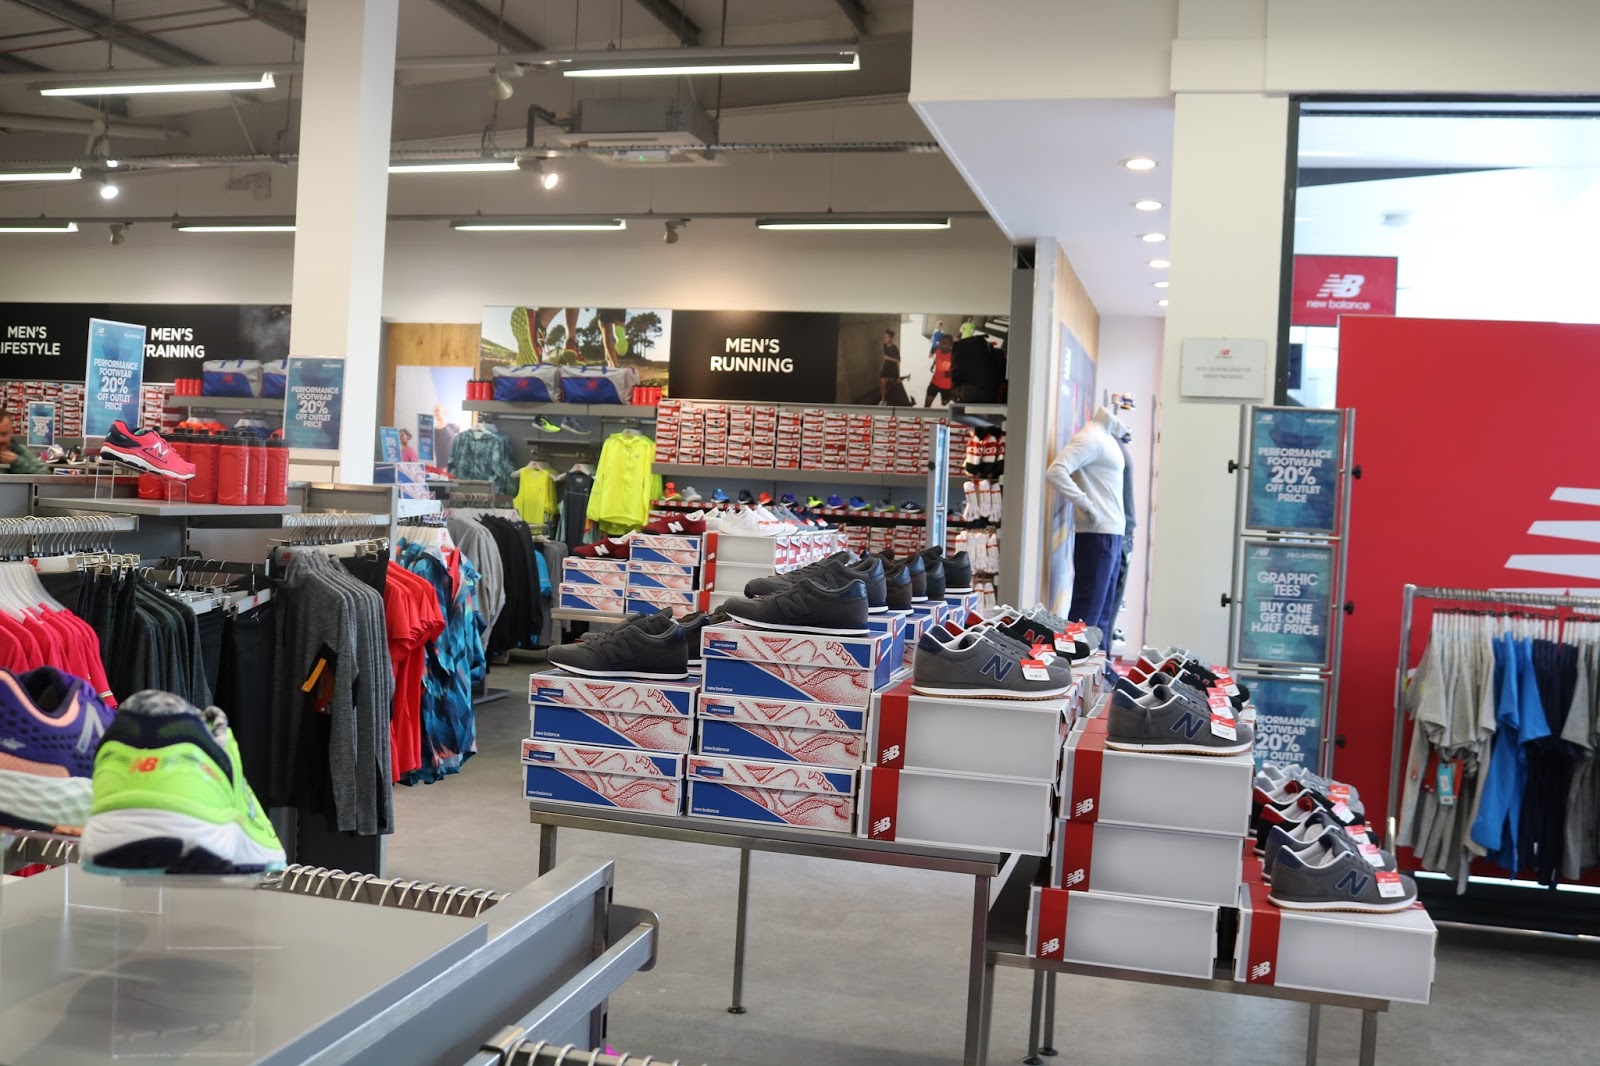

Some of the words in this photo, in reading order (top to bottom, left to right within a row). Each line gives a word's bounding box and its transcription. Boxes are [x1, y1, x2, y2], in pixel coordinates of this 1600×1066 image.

[1306, 300, 1327, 309] new
[1328, 299, 1371, 310] balance
[7, 325, 47, 340] MEN'S
[150, 327, 194, 342] MEN'S
[0, 341, 61, 356] IFESTYLE
[144, 343, 205, 359] RAINING
[725, 337, 780, 354] MEN'S
[94, 358, 138, 371] PERFORMANCE
[710, 355, 794, 373] RUNNING
[99, 367, 132, 379] FOOTWEAR
[101, 376, 129, 395] 20%
[291, 386, 339, 395] PERFORMANCE
[97, 392, 110, 402] OFF
[110, 393, 131, 403] OUTLET
[297, 393, 332, 401] FOOTWEAR
[105, 402, 122, 411] PRICE
[299, 400, 329, 414] 20%
[303, 420, 322, 428] PRICE
[1258, 447, 1333, 459] PERFORMANCE
[1267, 456, 1322, 468] FOOTWEAR
[1270, 466, 1316, 485] 20%
[1265, 483, 1283, 493] OFF
[1285, 484, 1321, 495] OUTLET
[1277, 493, 1307, 503] PRICE
[594, 544, 610, 556] N
[1257, 571, 1318, 586] GRAPHIC
[1273, 584, 1301, 597] TEES
[1260, 602, 1284, 612] BUY
[1286, 603, 1313, 614] ONE
[1260, 612, 1283, 622] GET
[1285, 613, 1312, 624] ONE
[1251, 622, 1281, 633] HALF
[1283, 624, 1319, 636] PRICE
[980, 652, 1015, 682] N
[1170, 711, 1206, 740] N
[1257, 724, 1306, 735] OOTWEAR
[1255, 732, 1301, 753] 20%
[1252, 750, 1268, 759] OFF
[1270, 752, 1304, 762] OUTLET
[1335, 868, 1369, 897] N
